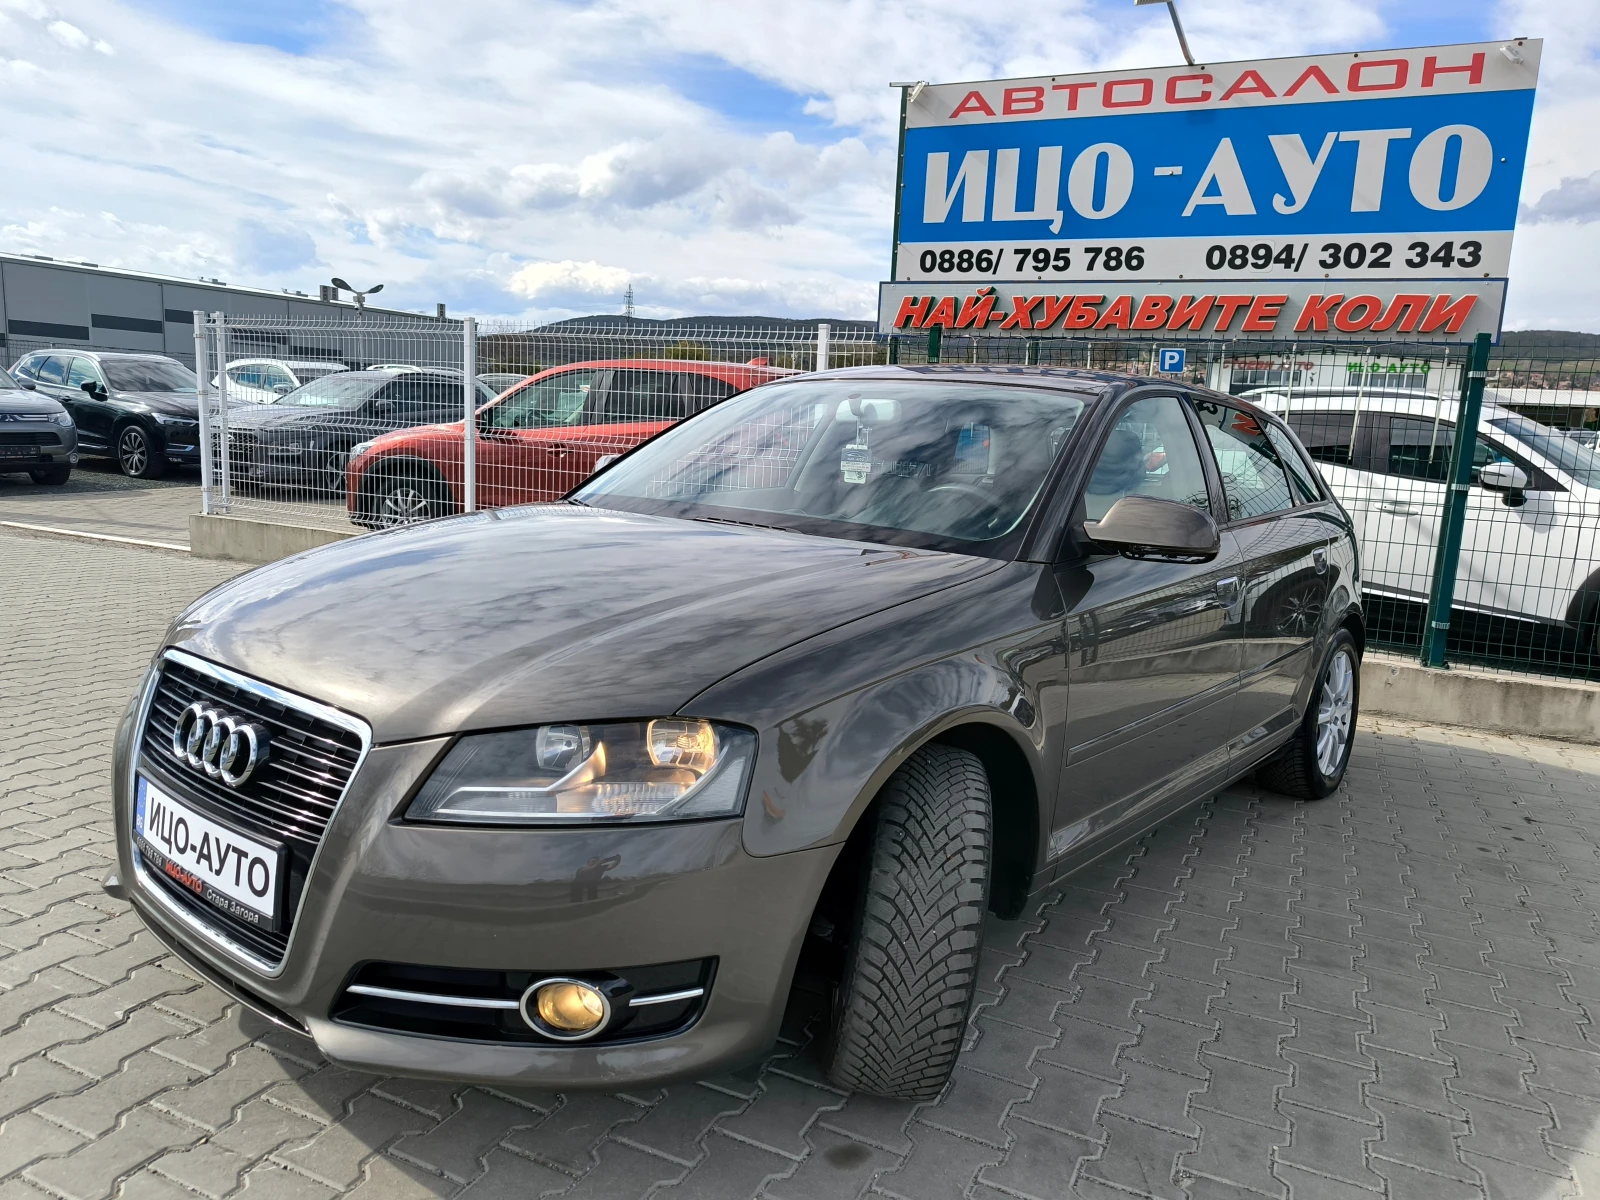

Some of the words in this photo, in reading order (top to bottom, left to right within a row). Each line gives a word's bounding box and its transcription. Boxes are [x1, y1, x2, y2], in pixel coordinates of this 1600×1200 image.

[949, 52, 1485, 119] АВТОСАЛОН
[919, 248, 1004, 274] 0886/
[1013, 247, 1071, 272] 795
[1084, 246, 1145, 271] 786
[1205, 242, 1309, 272] 0894/
[1318, 242, 1393, 269] 302
[1405, 240, 1482, 268] 343
[893, 286, 1288, 333] НАЙ-ХУБАВИТЕ
[1293, 293, 1479, 333] КОЛИ
[1164, 351, 1180, 370] P
[149, 797, 270, 898] ИЦО-АУТО
[206, 889, 229, 909] Стара
[229, 901, 259, 923] Загора
